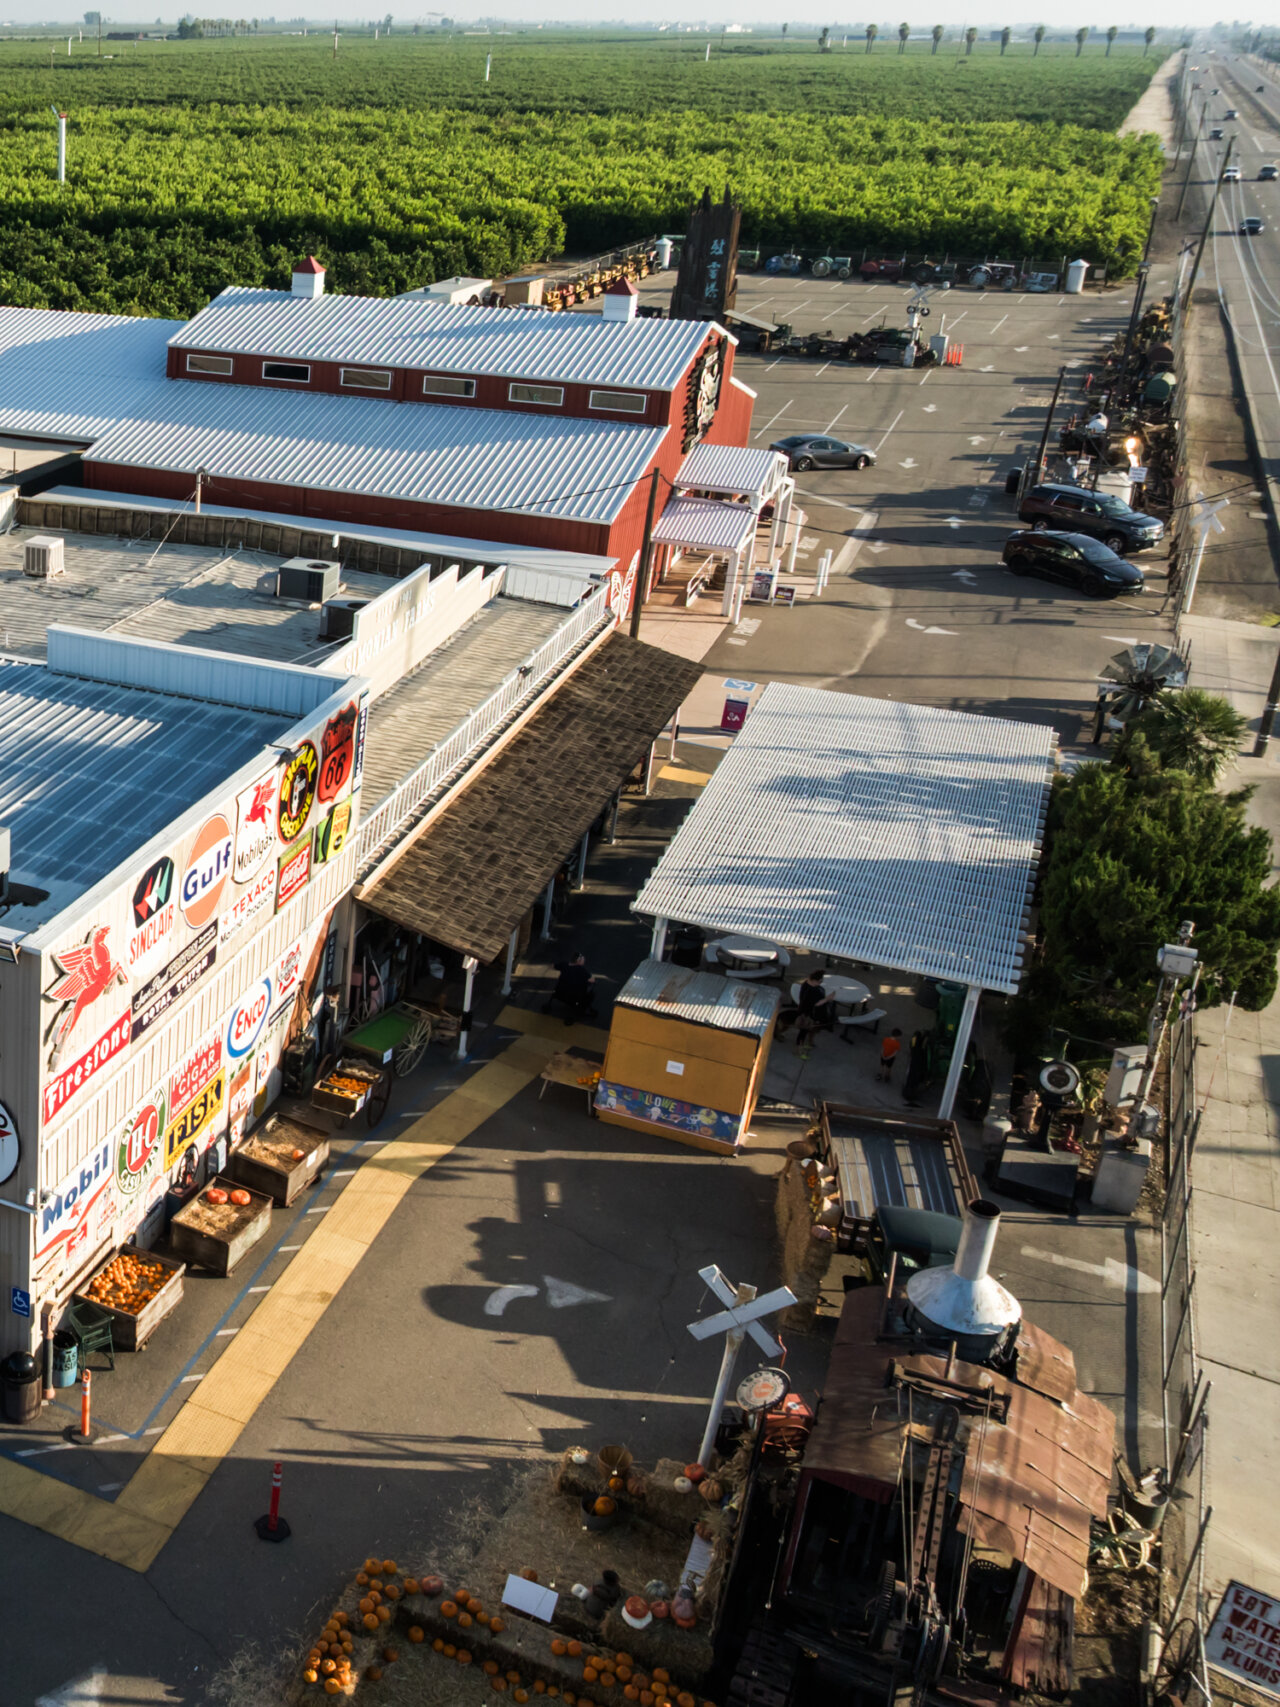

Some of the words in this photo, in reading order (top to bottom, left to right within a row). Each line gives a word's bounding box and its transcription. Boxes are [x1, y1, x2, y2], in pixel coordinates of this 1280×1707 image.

[325, 751, 347, 790] 66
[183, 840, 232, 902] Gulf
[232, 869, 275, 919] TEXACO
[129, 904, 174, 966] SINCLAIR
[142, 991, 172, 1025] ROYAL
[176, 956, 209, 992] TRITON
[234, 994, 266, 1041] ENCO
[45, 1018, 130, 1118] Firestone
[179, 1050, 215, 1094] CIGAR
[173, 1078, 219, 1153] FISK
[42, 1143, 109, 1236] Mobil
[1233, 1588, 1273, 1618] EBT
[1221, 1646, 1280, 1685] PLUMS
